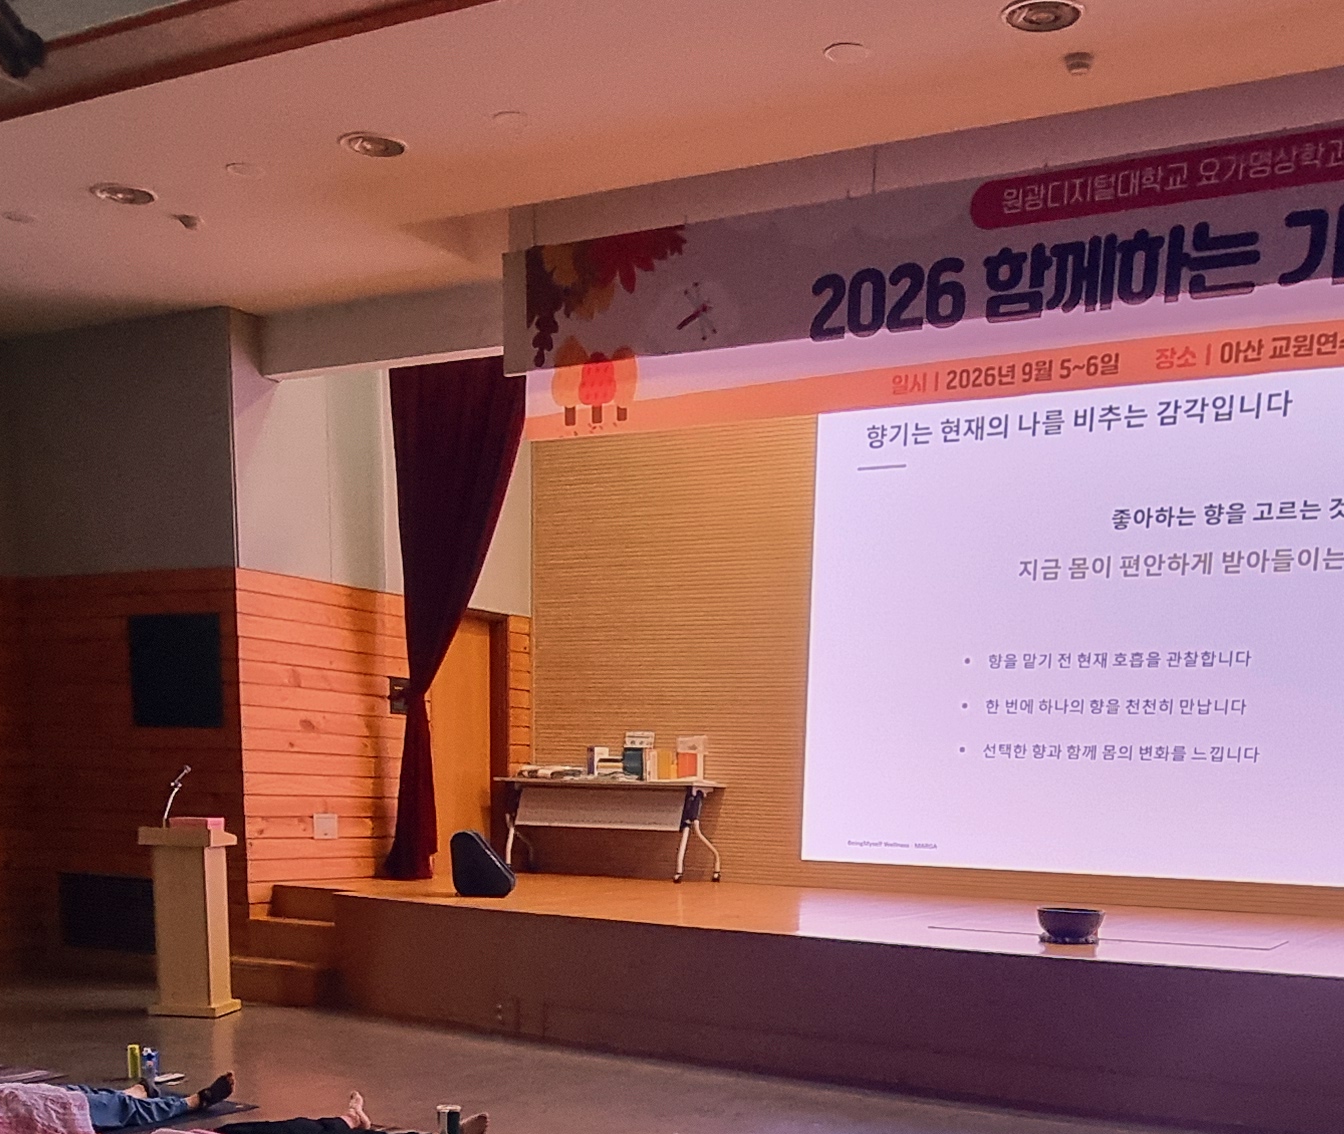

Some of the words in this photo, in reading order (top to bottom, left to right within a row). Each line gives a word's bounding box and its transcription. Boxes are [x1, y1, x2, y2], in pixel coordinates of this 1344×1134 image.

[1002, 161, 1188, 214] 원광디지털대학교
[810, 256, 965, 341] 2026
[983, 221, 1260, 323] 함께하는
[1155, 347, 1197, 370] 장소
[1219, 338, 1264, 364] 아산
[892, 372, 927, 395] 일시
[946, 363, 1016, 390] 2026년
[1021, 359, 1053, 383] 9월
[1059, 353, 1120, 379] 5~6일
[866, 421, 934, 450] 향기는
[940, 413, 1009, 444] 현재의
[1017, 409, 1066, 438] 나를
[1073, 403, 1149, 433] 비추는
[1156, 389, 1294, 427] 감각입니다
[1111, 505, 1197, 531] 좋아하는
[1203, 502, 1247, 526] 향을
[1252, 499, 1322, 522] 고르는
[1018, 558, 1062, 582] 지금
[1067, 555, 1112, 580] 몸이
[1118, 551, 1214, 578] 편안하게
[988, 653, 1018, 670] 향을
[1022, 652, 1053, 670] 맡기
[1057, 652, 1072, 669] 전
[1077, 651, 1109, 669] 현재
[1111, 650, 1162, 669] 호흡을
[1165, 649, 1253, 668] 관찰합니다
[985, 698, 1000, 715] 한
[1005, 698, 1034, 715] 번에
[1038, 698, 1085, 715] 하나의
[1089, 698, 1121, 715] 향을
[1124, 698, 1174, 716] 천천히
[1179, 697, 1248, 716] 만납니다
[982, 742, 1028, 760] 선택한
[1031, 743, 1063, 761] 향과
[1066, 744, 1098, 761] 함께
[1101, 744, 1133, 762] 몸의
[1138, 744, 1187, 762] 변화를
[1190, 745, 1261, 764] 느낍니다
